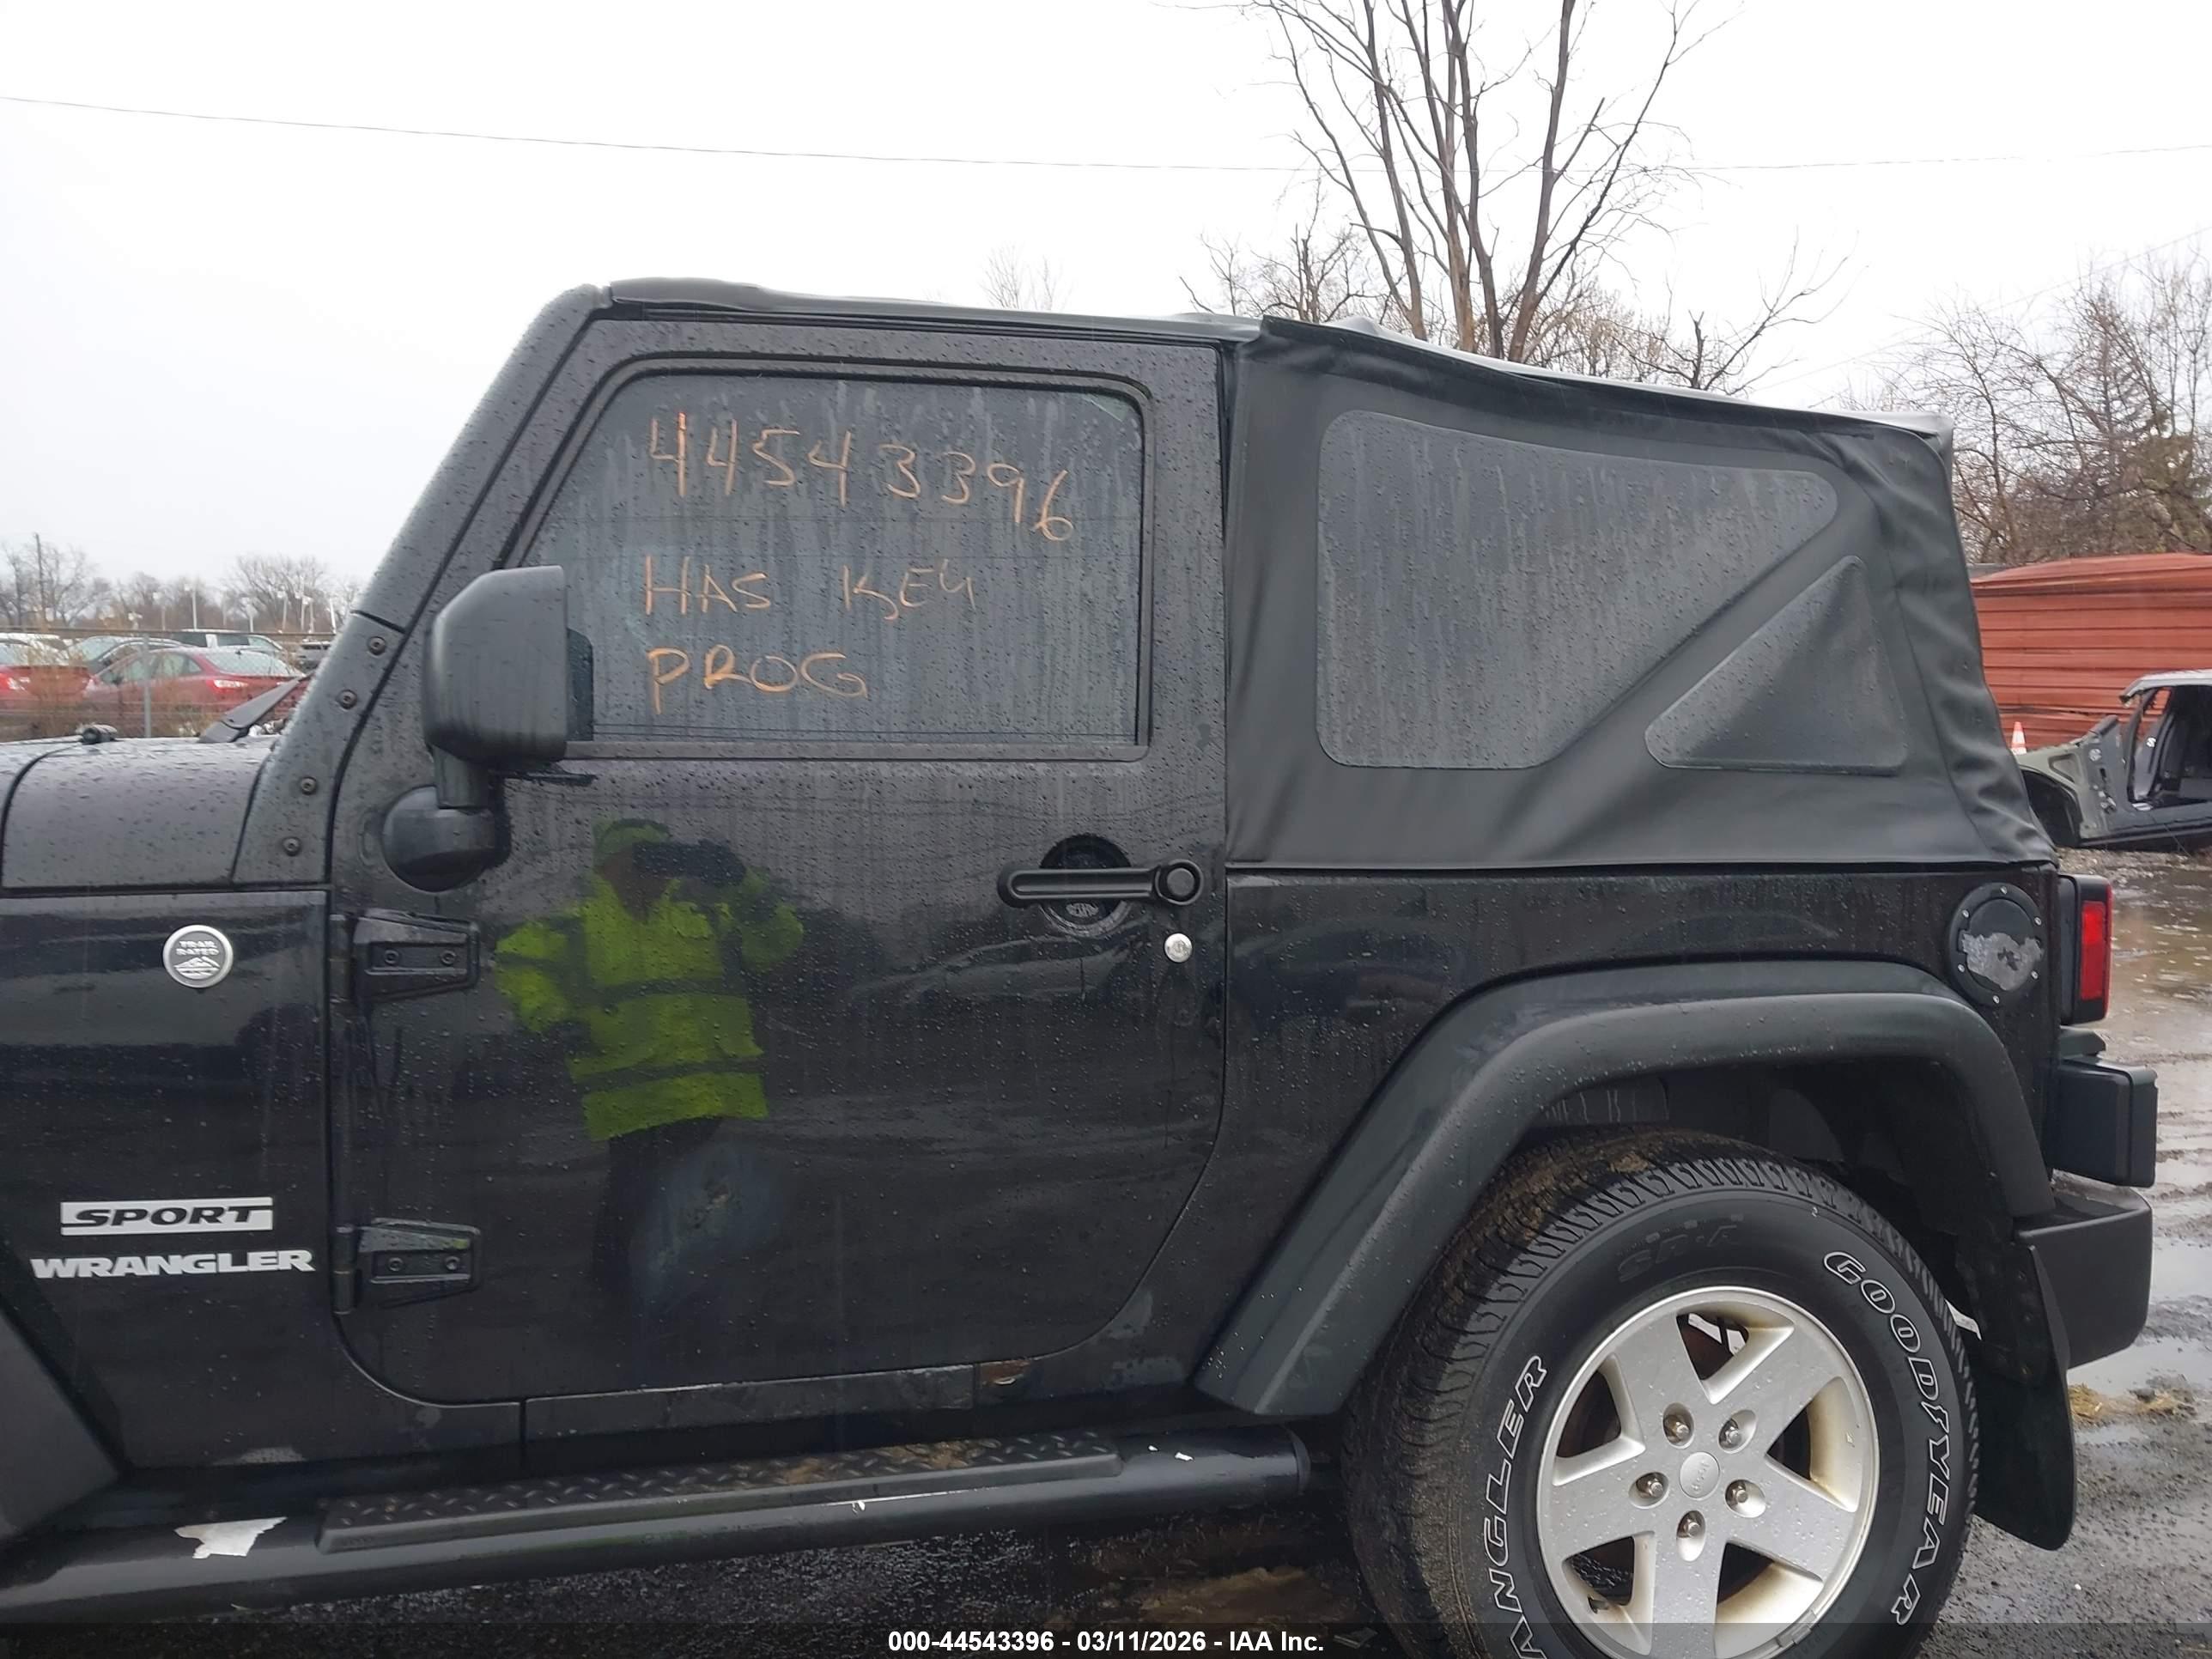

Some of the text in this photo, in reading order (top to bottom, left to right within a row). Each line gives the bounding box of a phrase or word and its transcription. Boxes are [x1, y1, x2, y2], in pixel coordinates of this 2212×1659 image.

[649, 412, 1073, 541] 44543396
[645, 556, 772, 616] HAS
[647, 644, 868, 714] PROG
[74, 1204, 259, 1229] SPORT
[29, 1249, 317, 1279] WRANGLER
[1823, 1251, 1951, 1626] GOODYEAR
